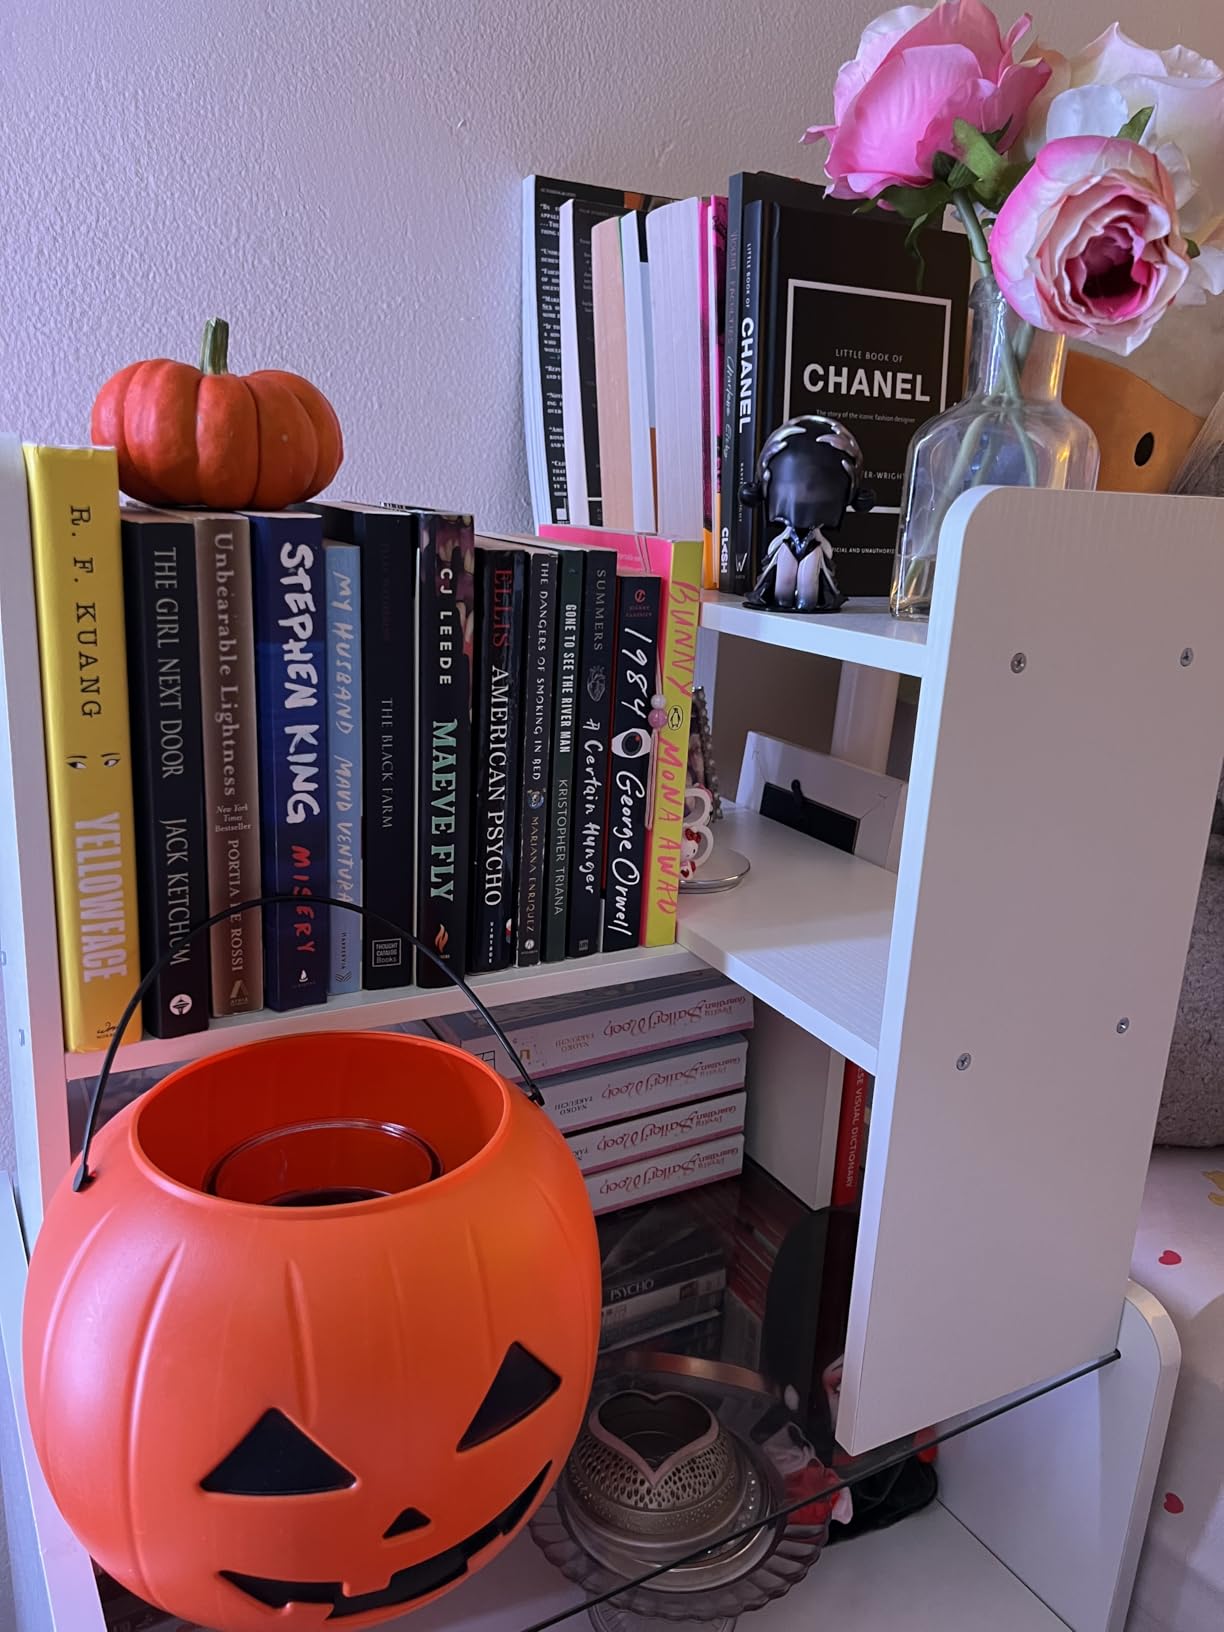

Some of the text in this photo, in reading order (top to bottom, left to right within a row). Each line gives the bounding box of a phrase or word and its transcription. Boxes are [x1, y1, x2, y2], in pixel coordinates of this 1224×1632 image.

[738, 317, 755, 434] CHANEL
[802, 363, 930, 402] CHANEL
[836, 348, 904, 364] LITTLE BOOK OF
[816, 409, 826, 417] The
[894, 415, 917, 424] designer
[848, 546, 860, 554] AND
[70, 504, 102, 718] R. F. KUANG
[439, 568, 454, 685] CJ LEEDE
[493, 569, 513, 648] ELLIS
[593, 569, 607, 651] SUMMERS
[666, 580, 700, 697] BUNNY
[154, 547, 185, 779] THE GIRL NEXT DOOR
[213, 532, 241, 796] Unbearable Lightness
[278, 541, 320, 825] STEPHEN KING
[331, 571, 354, 735] MY HUSBAND
[532, 563, 550, 781] THE DANGERS OF SMOKING IN BED
[559, 603, 577, 753] GONE TO SEE THE RIVER MAN
[620, 627, 653, 719] 1984
[381, 697, 394, 828] THE BLACK FARM
[484, 665, 510, 907] AMERICAN PSYCHO
[160, 818, 189, 866] JACK
[215, 822, 251, 832] Bestseller
[333, 754, 355, 902] MAUD VENTURA
[430, 718, 459, 902] MAEVE FLY
[578, 718, 604, 894] A Certain Hunger
[228, 839, 241, 898] PORTIA
[525, 816, 540, 932] MARIANA ENRIQUEZ
[553, 779, 569, 916] KRISTOPHER TRIANA
[608, 770, 645, 936] George Orwell
[655, 836, 682, 915] AWAD
[74, 811, 128, 984] YELLOWFACE
[291, 845, 316, 953] MISERY
[231, 928, 244, 971] ROSSI
[375, 942, 398, 951] THOUGHT
[376, 956, 397, 964] Books
[602, 1000, 706, 1038] Sailor Moon
[703, 995, 747, 1010] Guardian
[554, 1096, 594, 1110] TAKEUCHI
[601, 1061, 702, 1100] Sailor Moon
[699, 1056, 741, 1071] Guardian
[559, 1104, 588, 1117] NAOKO
[596, 1110, 698, 1152] Sailor Moon
[696, 1105, 738, 1121] Guardian
[851, 1088, 863, 1125] VISUAL
[599, 1153, 701, 1196] Sailor Moon
[698, 1148, 739, 1163] Guardian
[845, 1127, 859, 1187] DICTIONARY
[609, 1279, 655, 1302] PSYCHO
